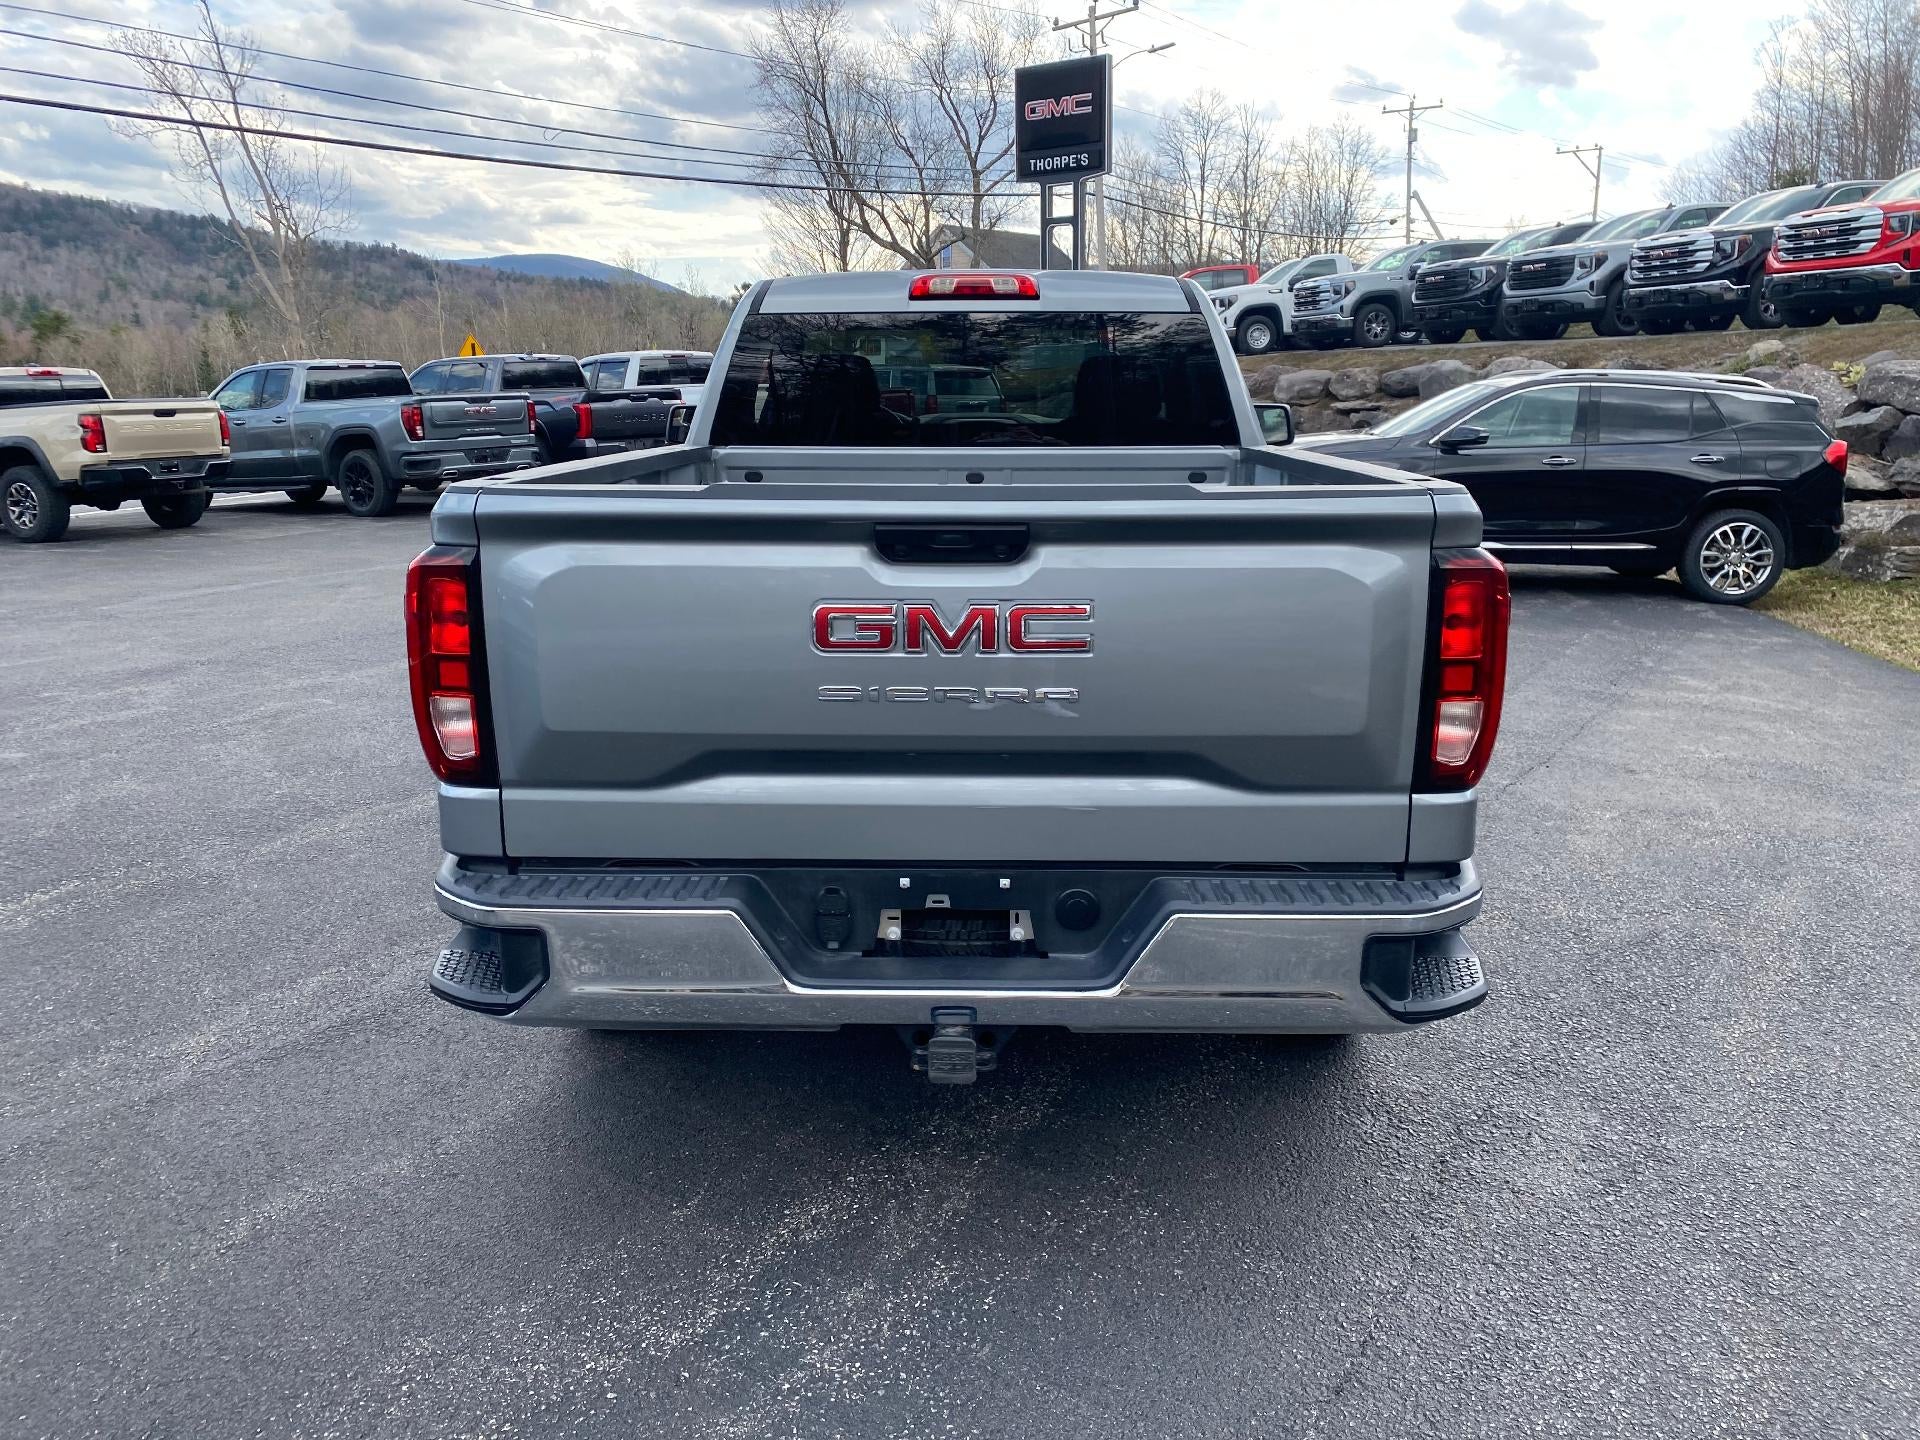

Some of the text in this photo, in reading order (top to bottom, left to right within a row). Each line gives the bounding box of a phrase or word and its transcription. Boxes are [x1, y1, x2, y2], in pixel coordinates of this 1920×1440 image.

[1024, 92, 1093, 121] GMC
[1029, 153, 1089, 171] THORPE'S
[464, 406, 497, 417] GMC
[614, 413, 667, 423] TUNDRA
[119, 422, 211, 433] CHEVROLET
[810, 598, 1095, 657] GMC
[817, 685, 1080, 704] SIERRA
